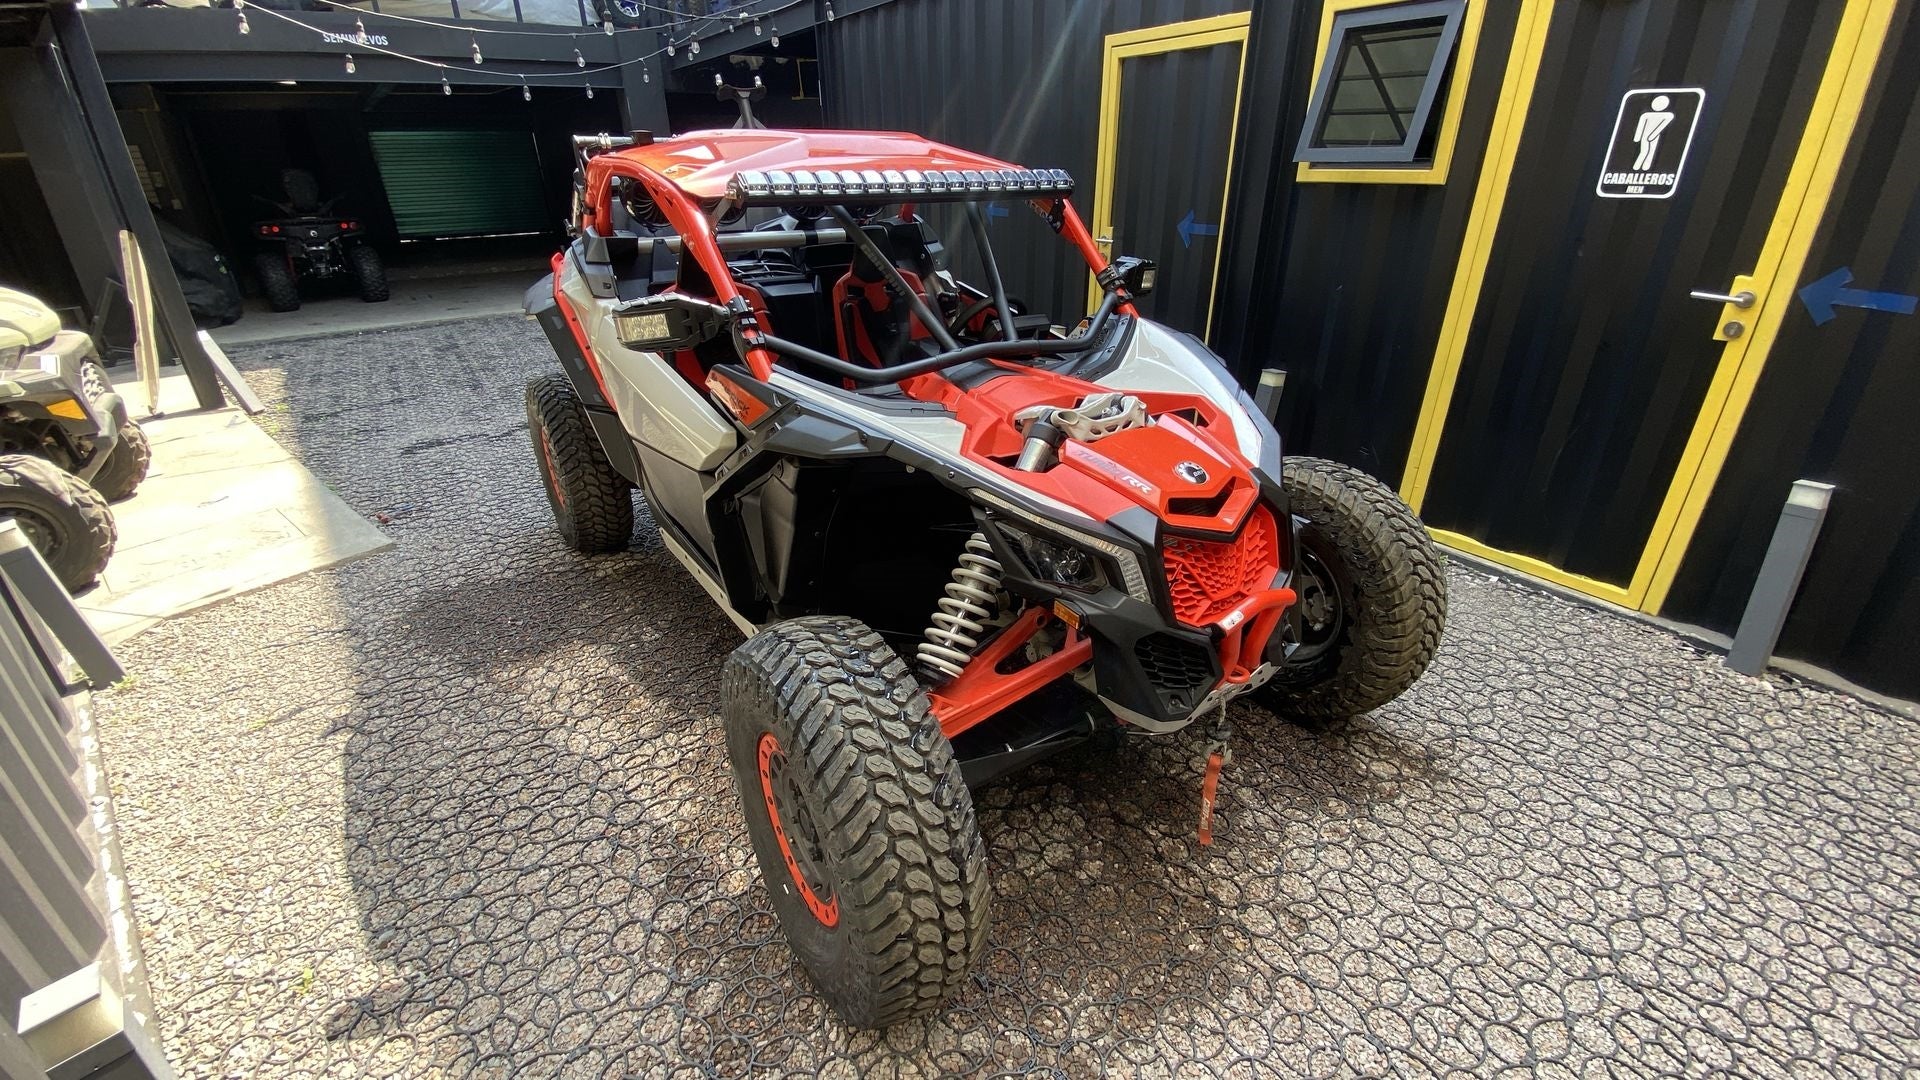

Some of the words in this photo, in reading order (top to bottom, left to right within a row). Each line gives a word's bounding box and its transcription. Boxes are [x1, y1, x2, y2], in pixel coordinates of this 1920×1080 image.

[1603, 172, 1675, 186] CABALLEROS
[1625, 185, 1645, 194] MEN
[1121, 474, 1153, 494] RR
